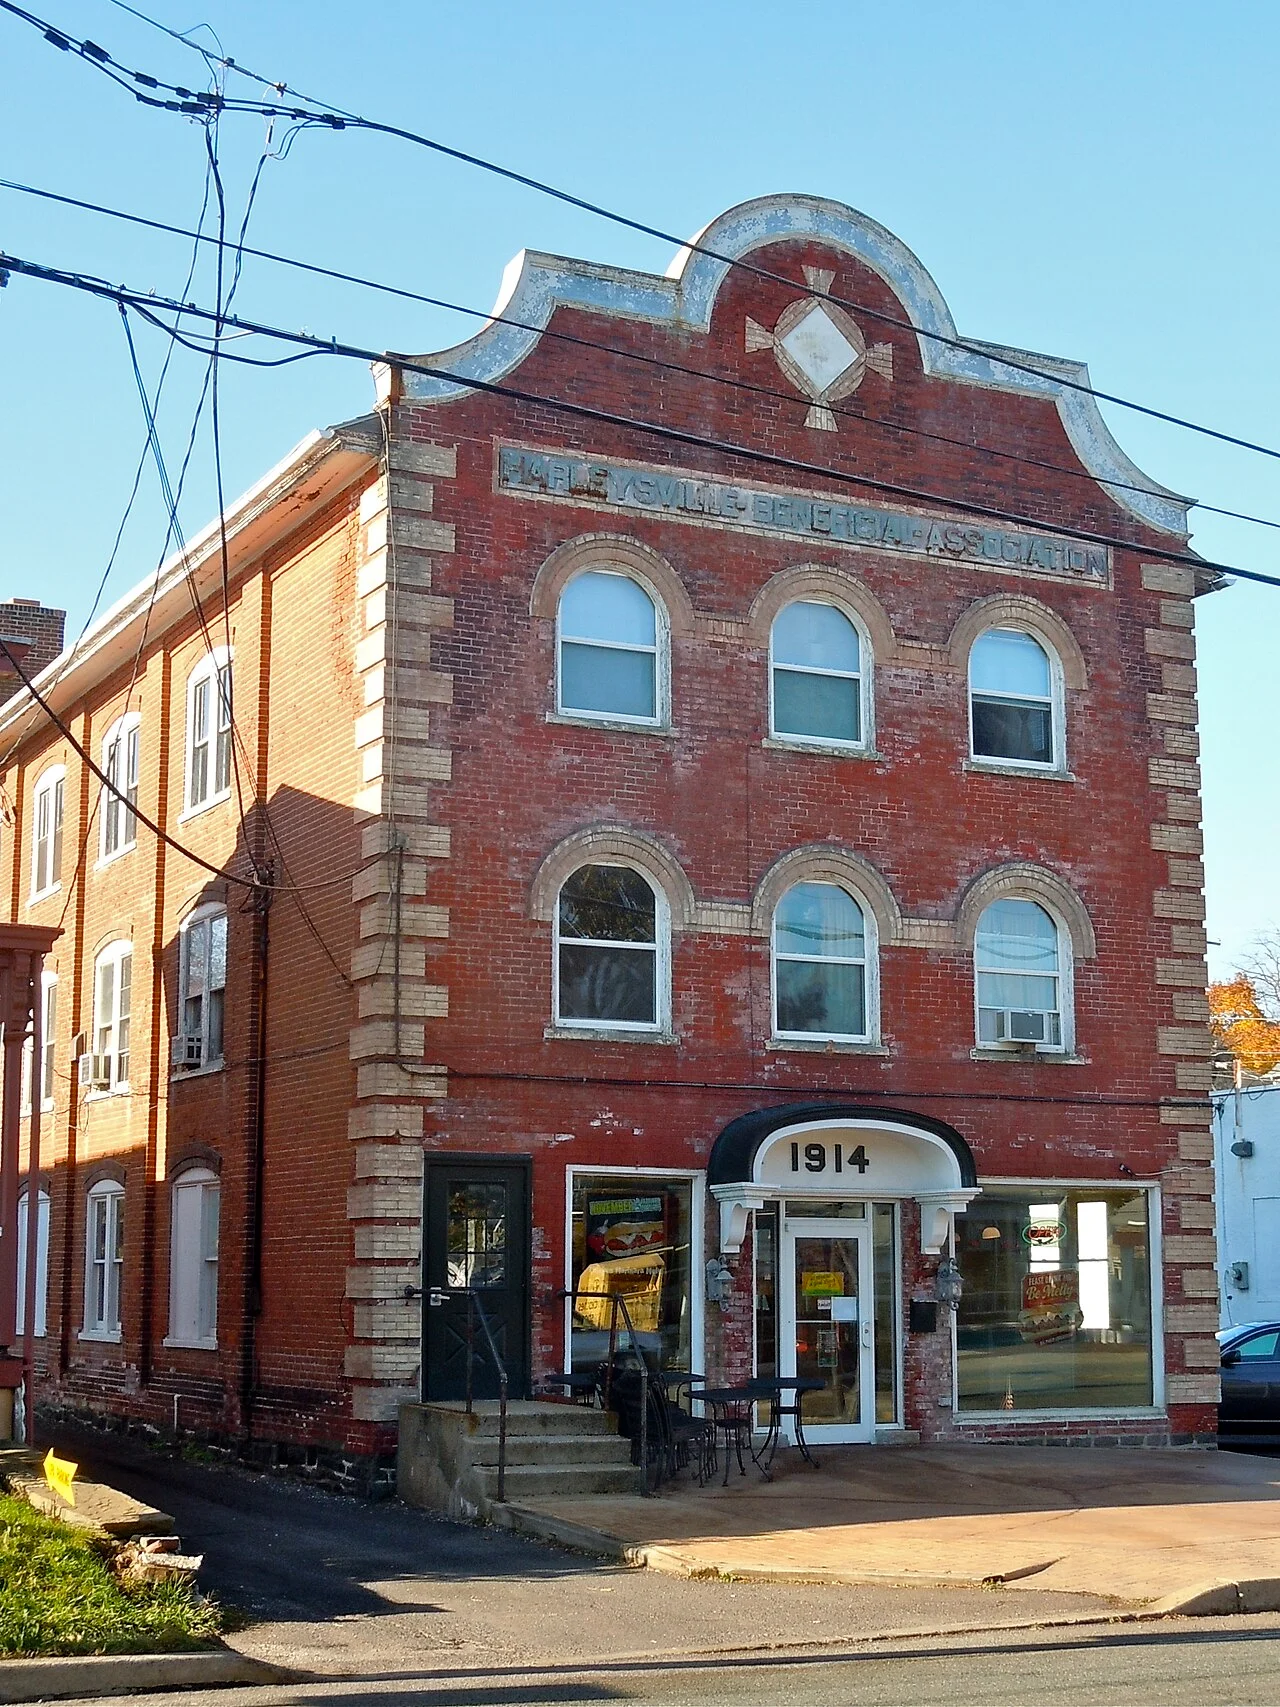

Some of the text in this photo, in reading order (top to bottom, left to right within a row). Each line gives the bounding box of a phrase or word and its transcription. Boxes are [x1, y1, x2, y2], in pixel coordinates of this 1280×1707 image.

[752, 494, 917, 548] BENEFICIAL
[925, 520, 1107, 577] ASSOCIATION
[791, 1143, 870, 1174] 1914
